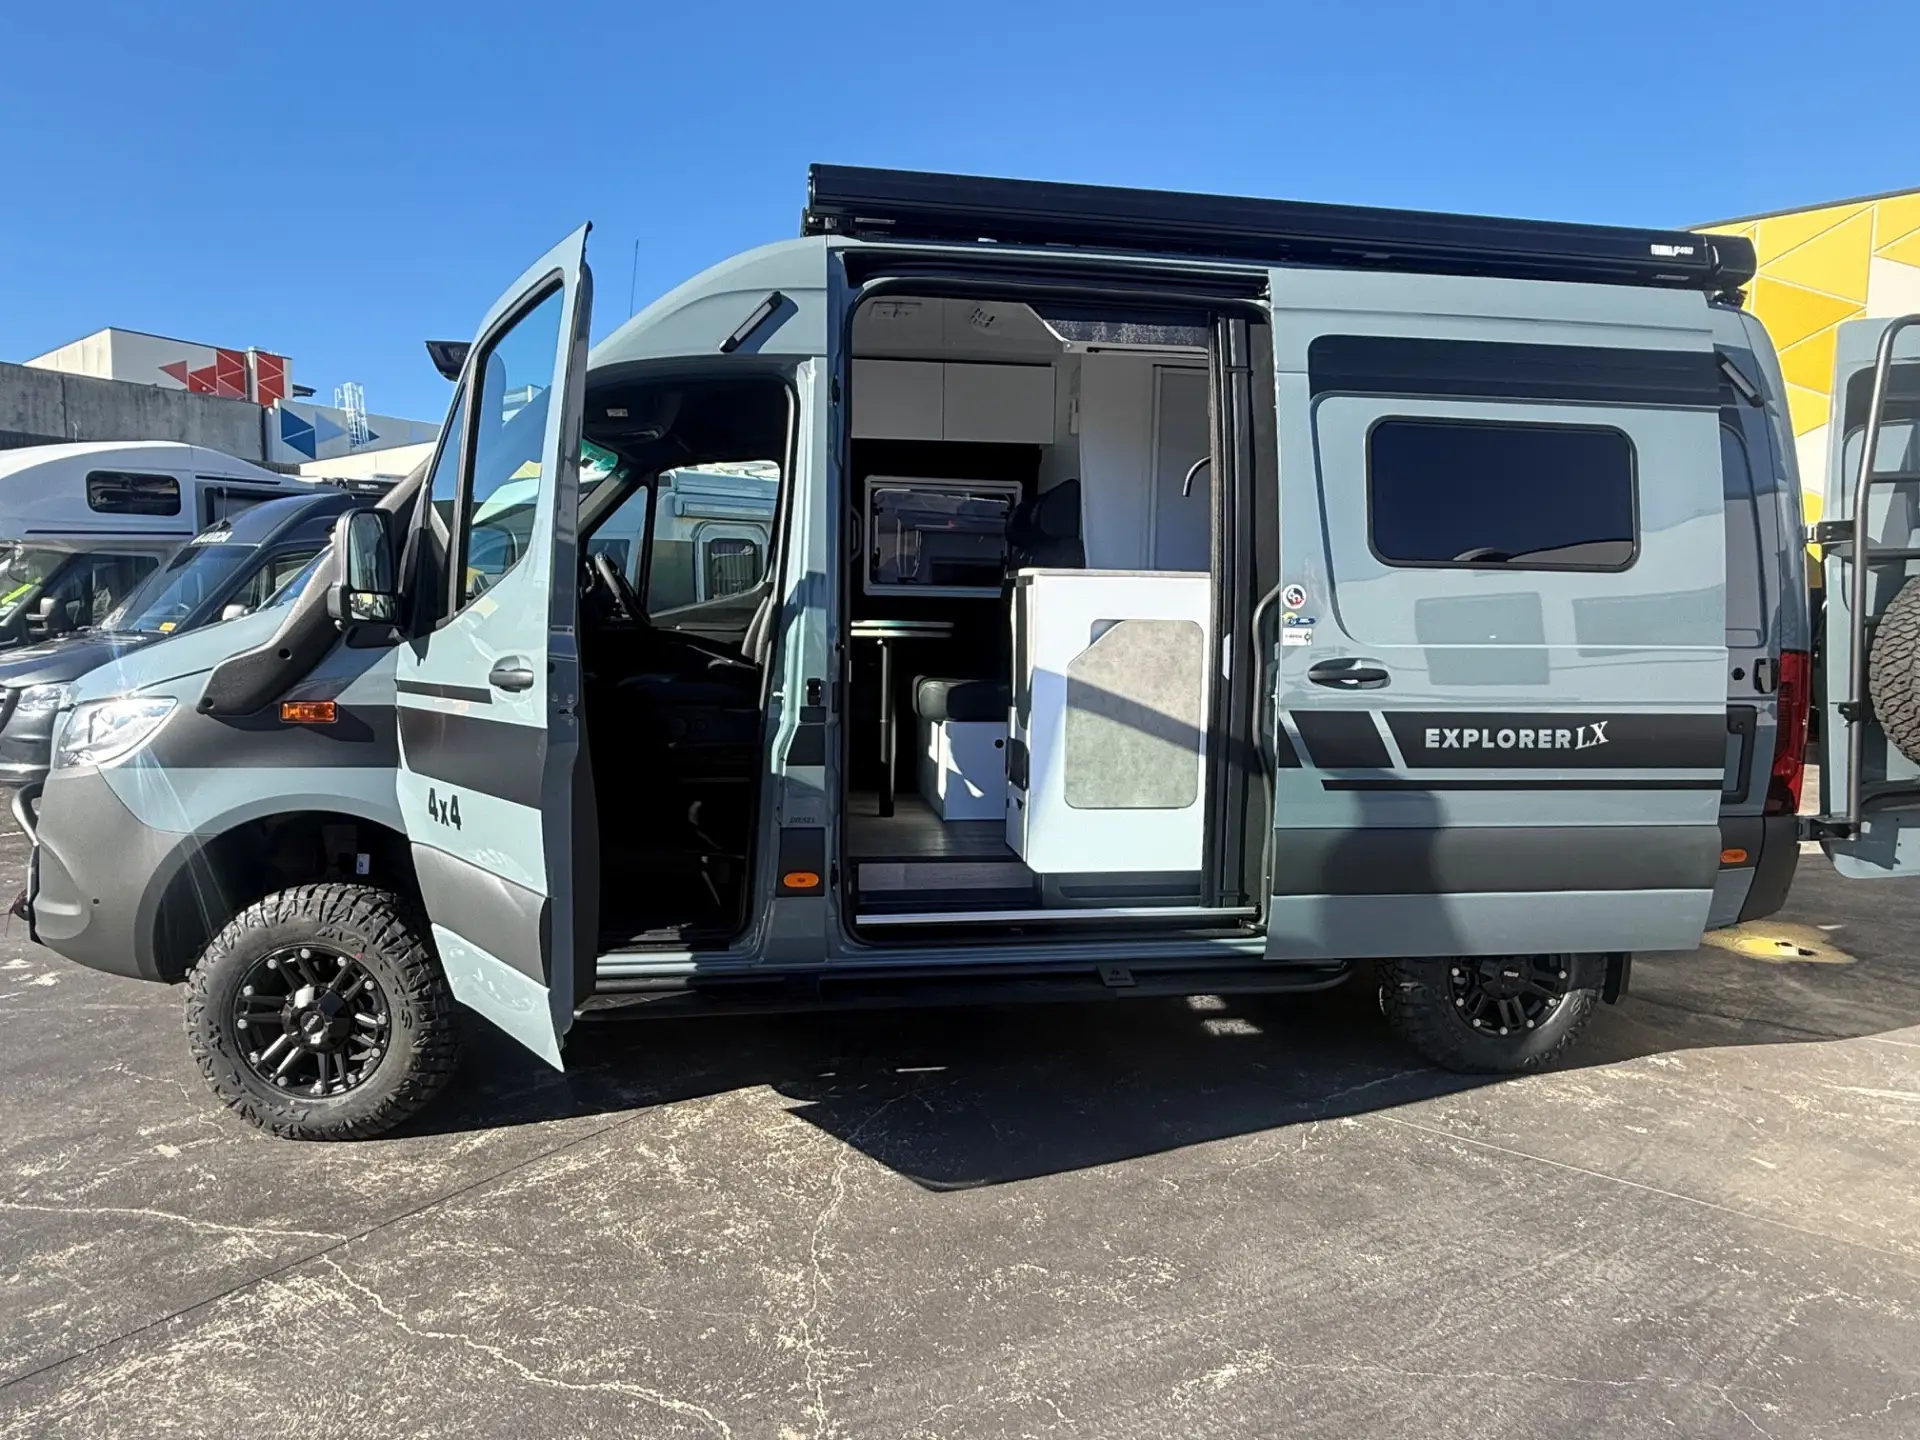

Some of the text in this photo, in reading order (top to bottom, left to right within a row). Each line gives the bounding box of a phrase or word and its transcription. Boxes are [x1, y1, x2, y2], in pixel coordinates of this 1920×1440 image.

[1425, 721, 1610, 750] EXPLORER LX
[428, 787, 462, 831] 4x4
